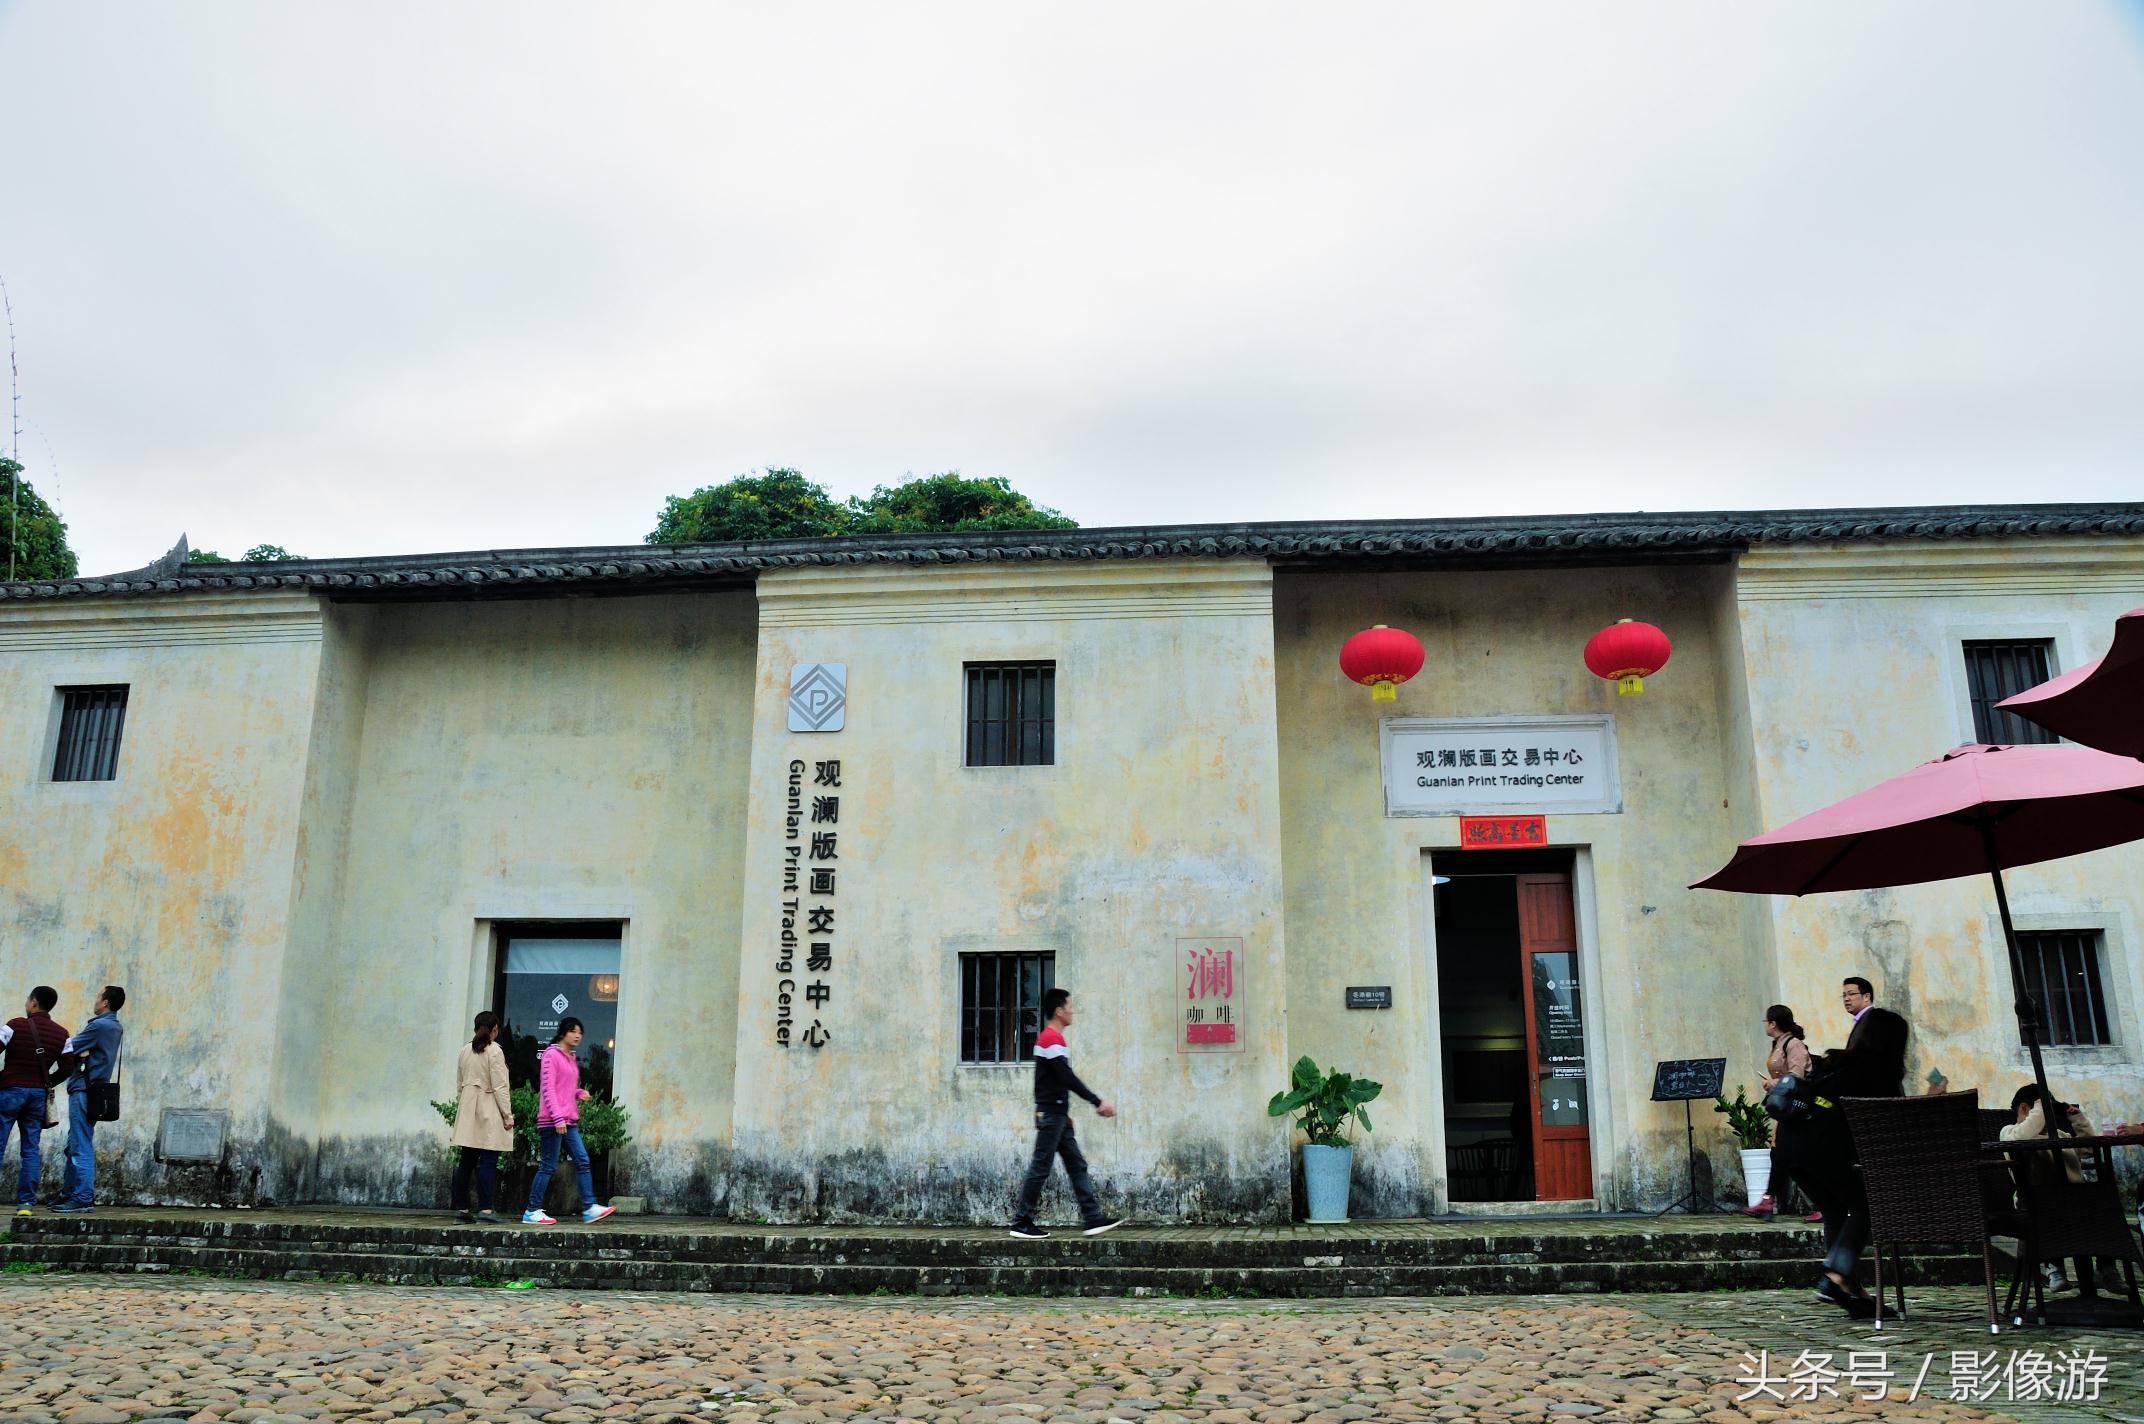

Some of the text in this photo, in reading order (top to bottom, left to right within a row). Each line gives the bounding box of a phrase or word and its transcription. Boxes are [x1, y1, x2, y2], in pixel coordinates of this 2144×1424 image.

[1416, 747, 1583, 769] 观澜版画交易中心
[1417, 773, 1584, 788] Guanlan Print Trading Center
[776, 759, 806, 1048] Guanlan Print Trading Center
[802, 759, 841, 1048] 观澜版画交易中心
[1187, 947, 1233, 1000] 澜
[1186, 1005, 1234, 1024] 咖啡
